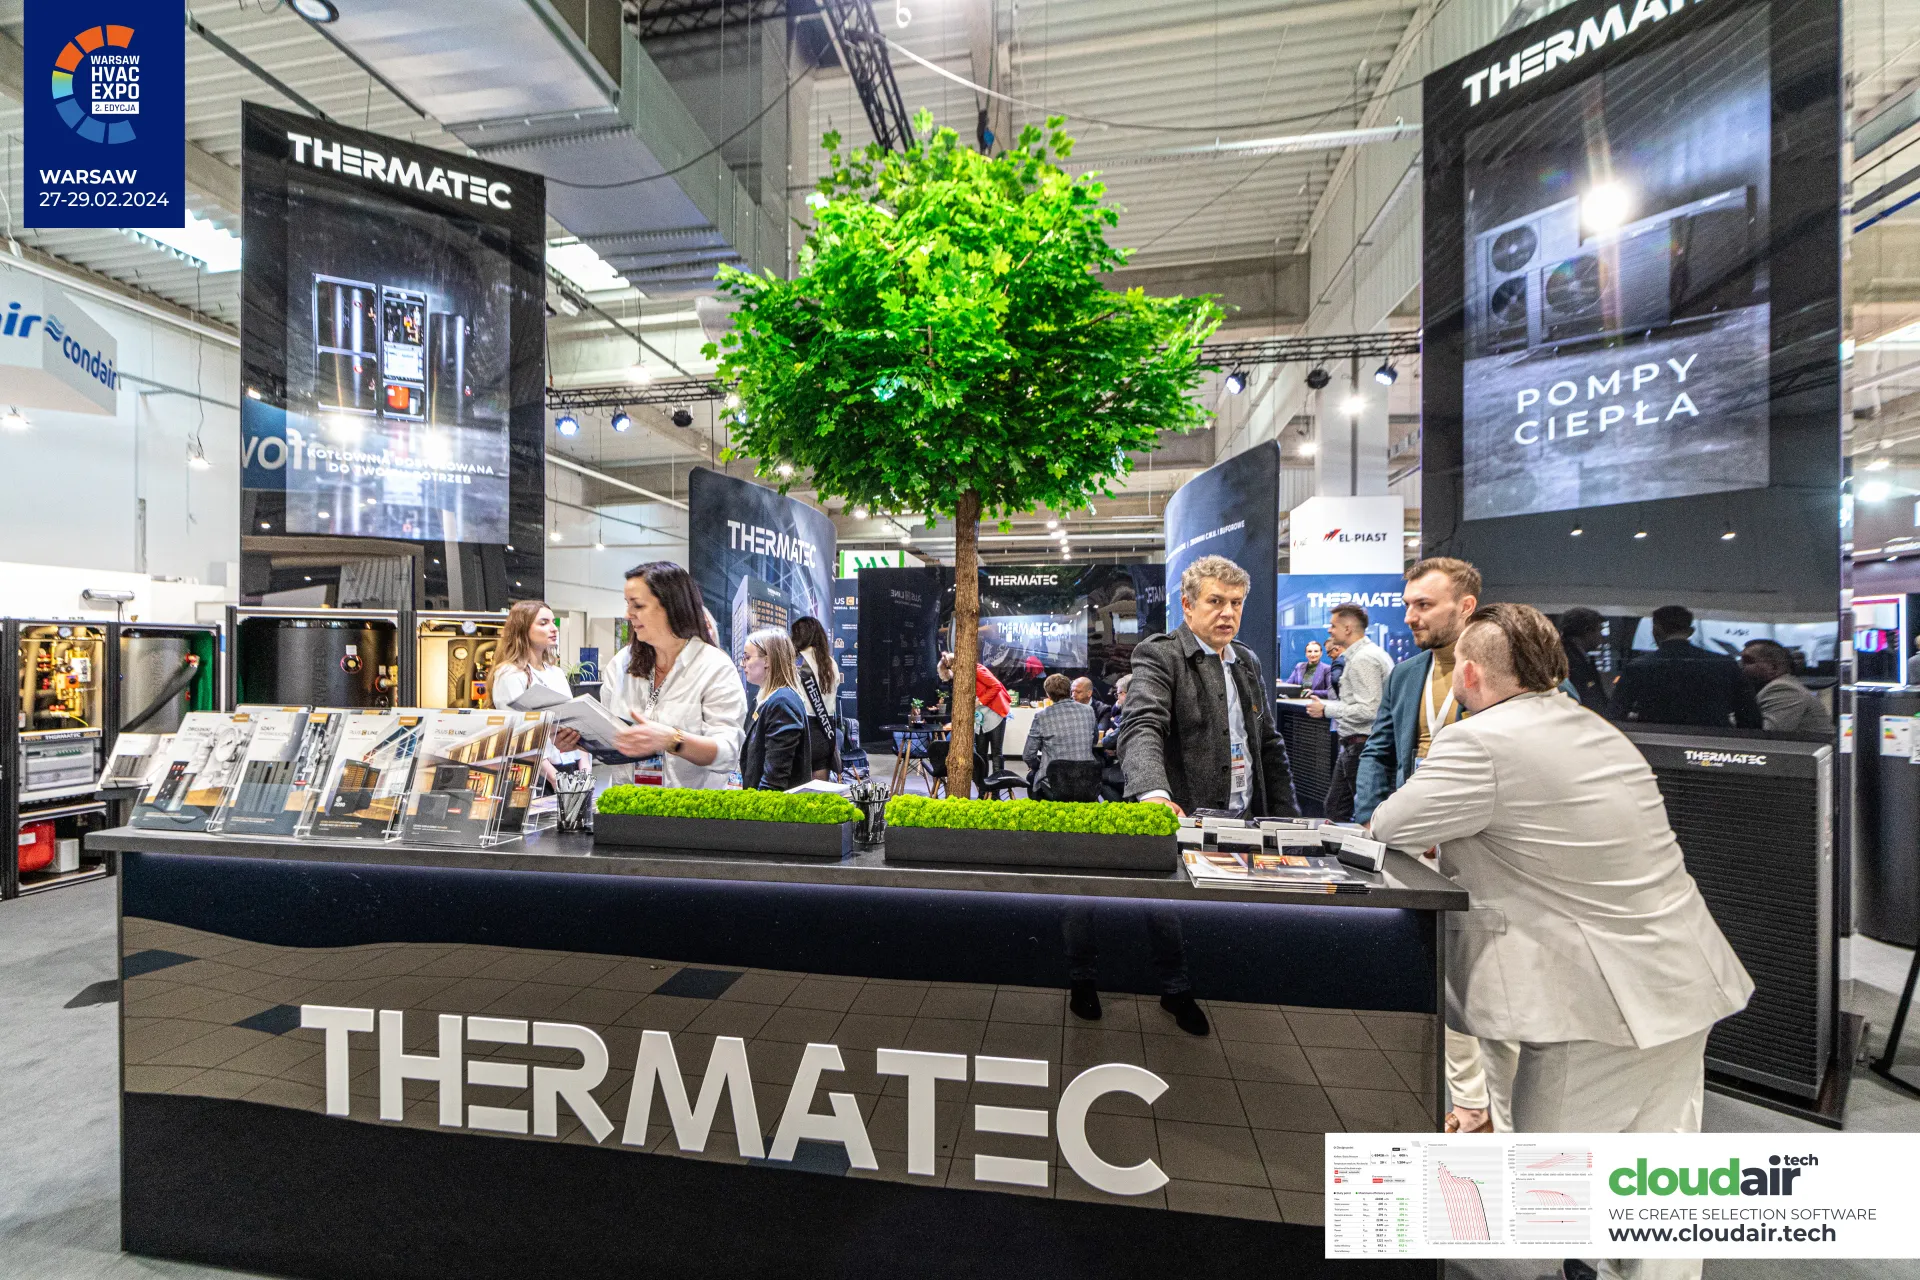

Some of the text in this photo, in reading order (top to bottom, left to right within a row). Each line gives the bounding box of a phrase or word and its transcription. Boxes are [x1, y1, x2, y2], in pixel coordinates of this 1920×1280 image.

[287, 131, 512, 210] THERMATEC
[0, 302, 42, 338] ir
[63, 335, 117, 390] condair
[1517, 353, 1699, 414] POMPY
[1514, 392, 1700, 445] CIEPŁA
[329, 463, 349, 474] DO
[728, 520, 816, 568] THERMATEC
[1339, 533, 1387, 542] EL-PIAST
[988, 575, 1058, 586] THERMATEC
[1307, 592, 1405, 608] THERMATE
[804, 676, 834, 740] THERMATEC
[1684, 750, 1767, 765] THERMATEC
[299, 1004, 1170, 1196] THERMATEC
